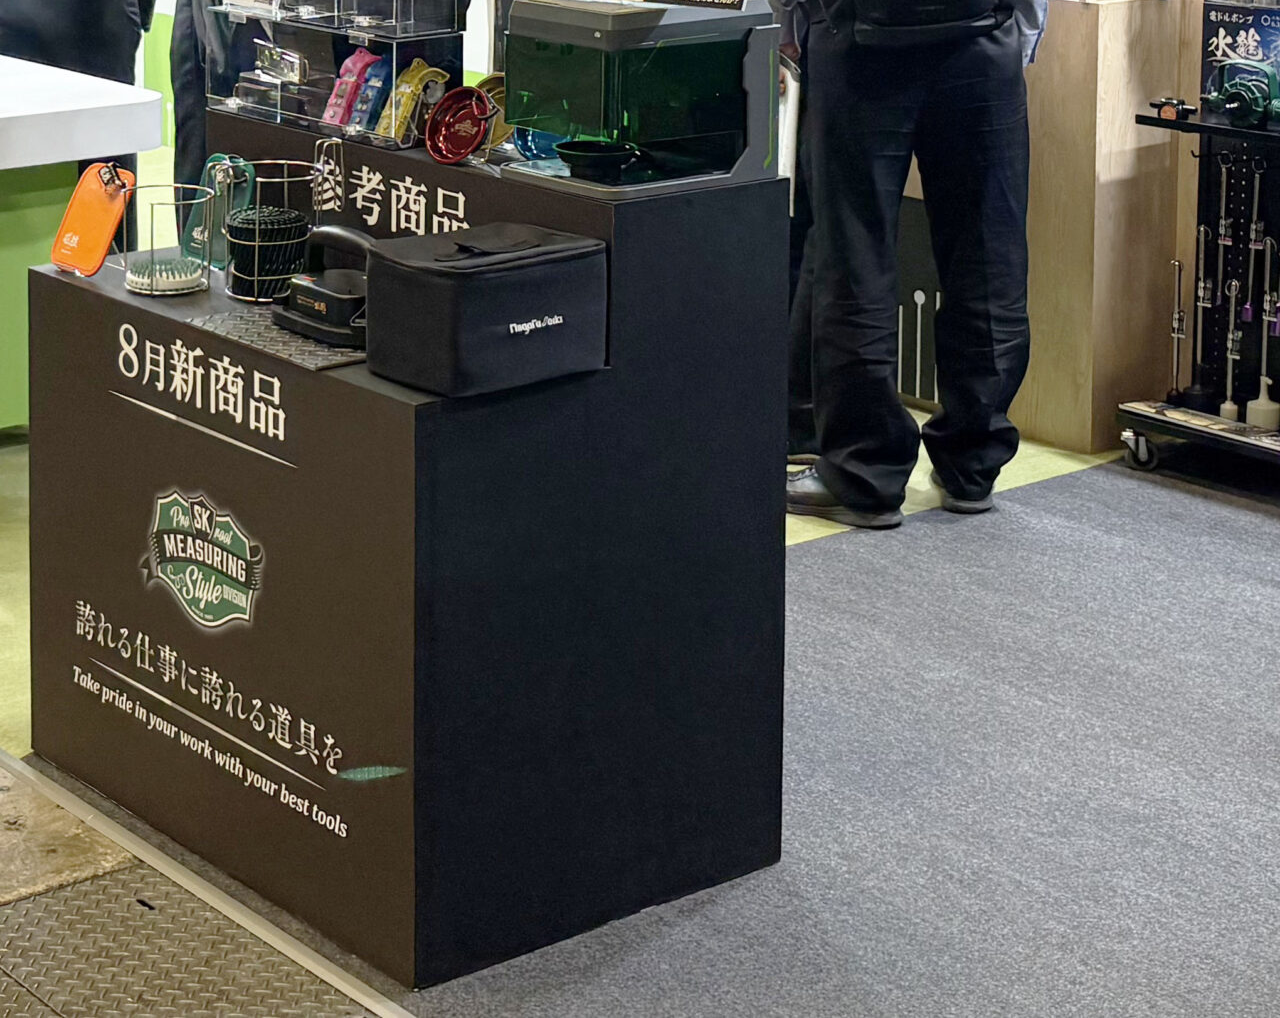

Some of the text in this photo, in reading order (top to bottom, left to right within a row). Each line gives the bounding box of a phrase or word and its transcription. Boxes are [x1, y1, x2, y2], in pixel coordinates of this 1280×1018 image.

[118, 323, 286, 441] 8月新商品
[163, 534, 247, 582] MEASURING
[193, 504, 211, 533] SK
[183, 565, 223, 609] Style
[76, 600, 343, 775] 誇れる仕事に誇れる道具を
[73, 665, 348, 838] Take pride in your work with your best tools
